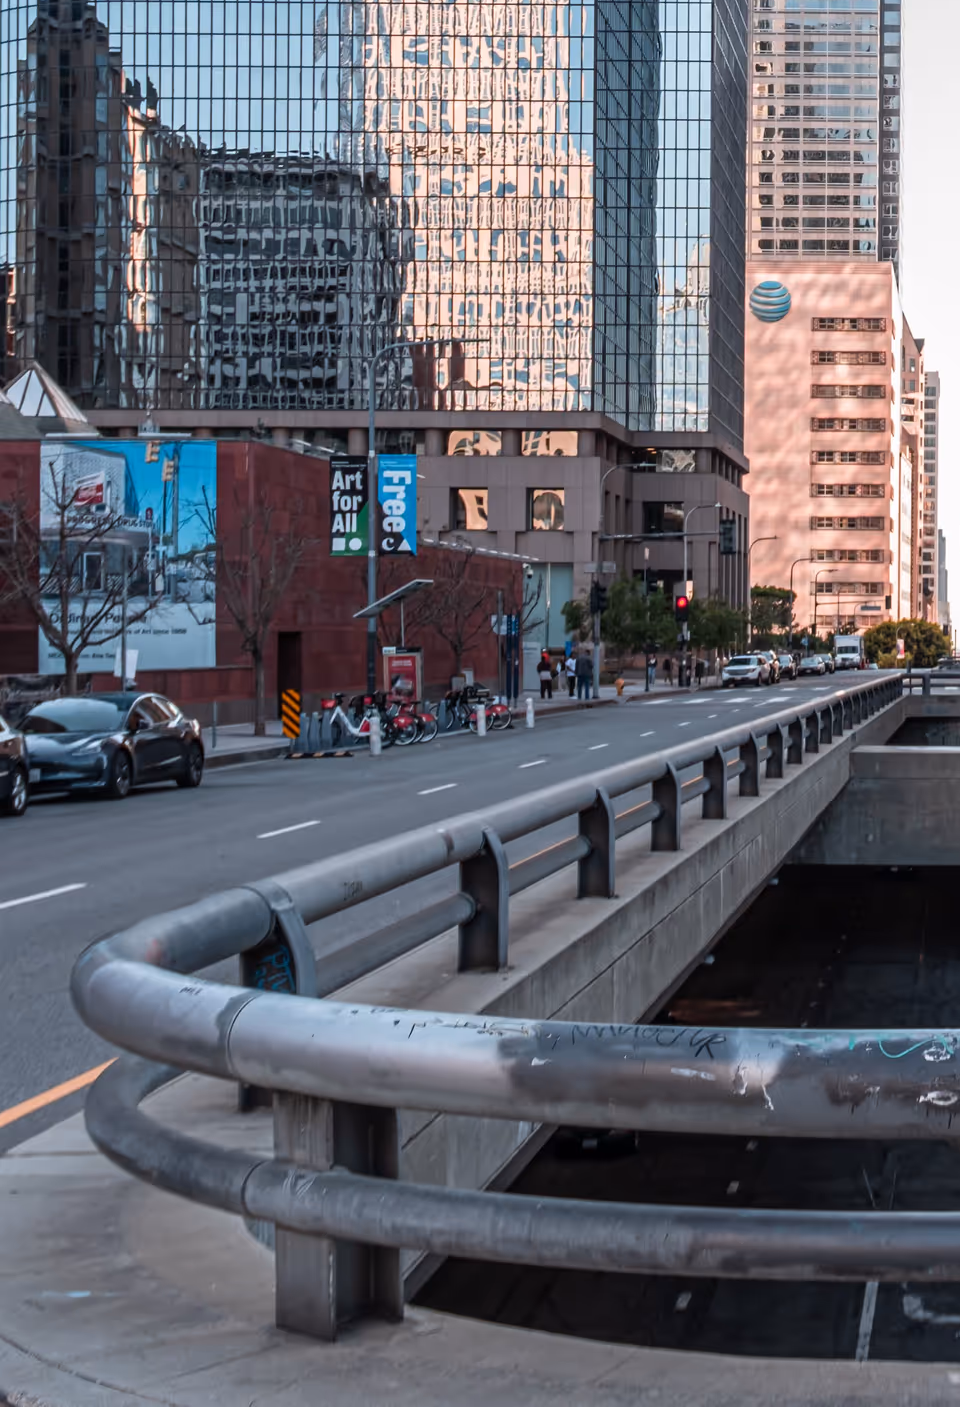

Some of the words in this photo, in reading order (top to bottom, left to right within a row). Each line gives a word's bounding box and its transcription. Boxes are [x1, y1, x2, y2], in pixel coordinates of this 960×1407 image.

[332, 470, 363, 490] Art
[332, 490, 363, 511] for
[382, 470, 412, 533] Free
[332, 513, 357, 533] All
